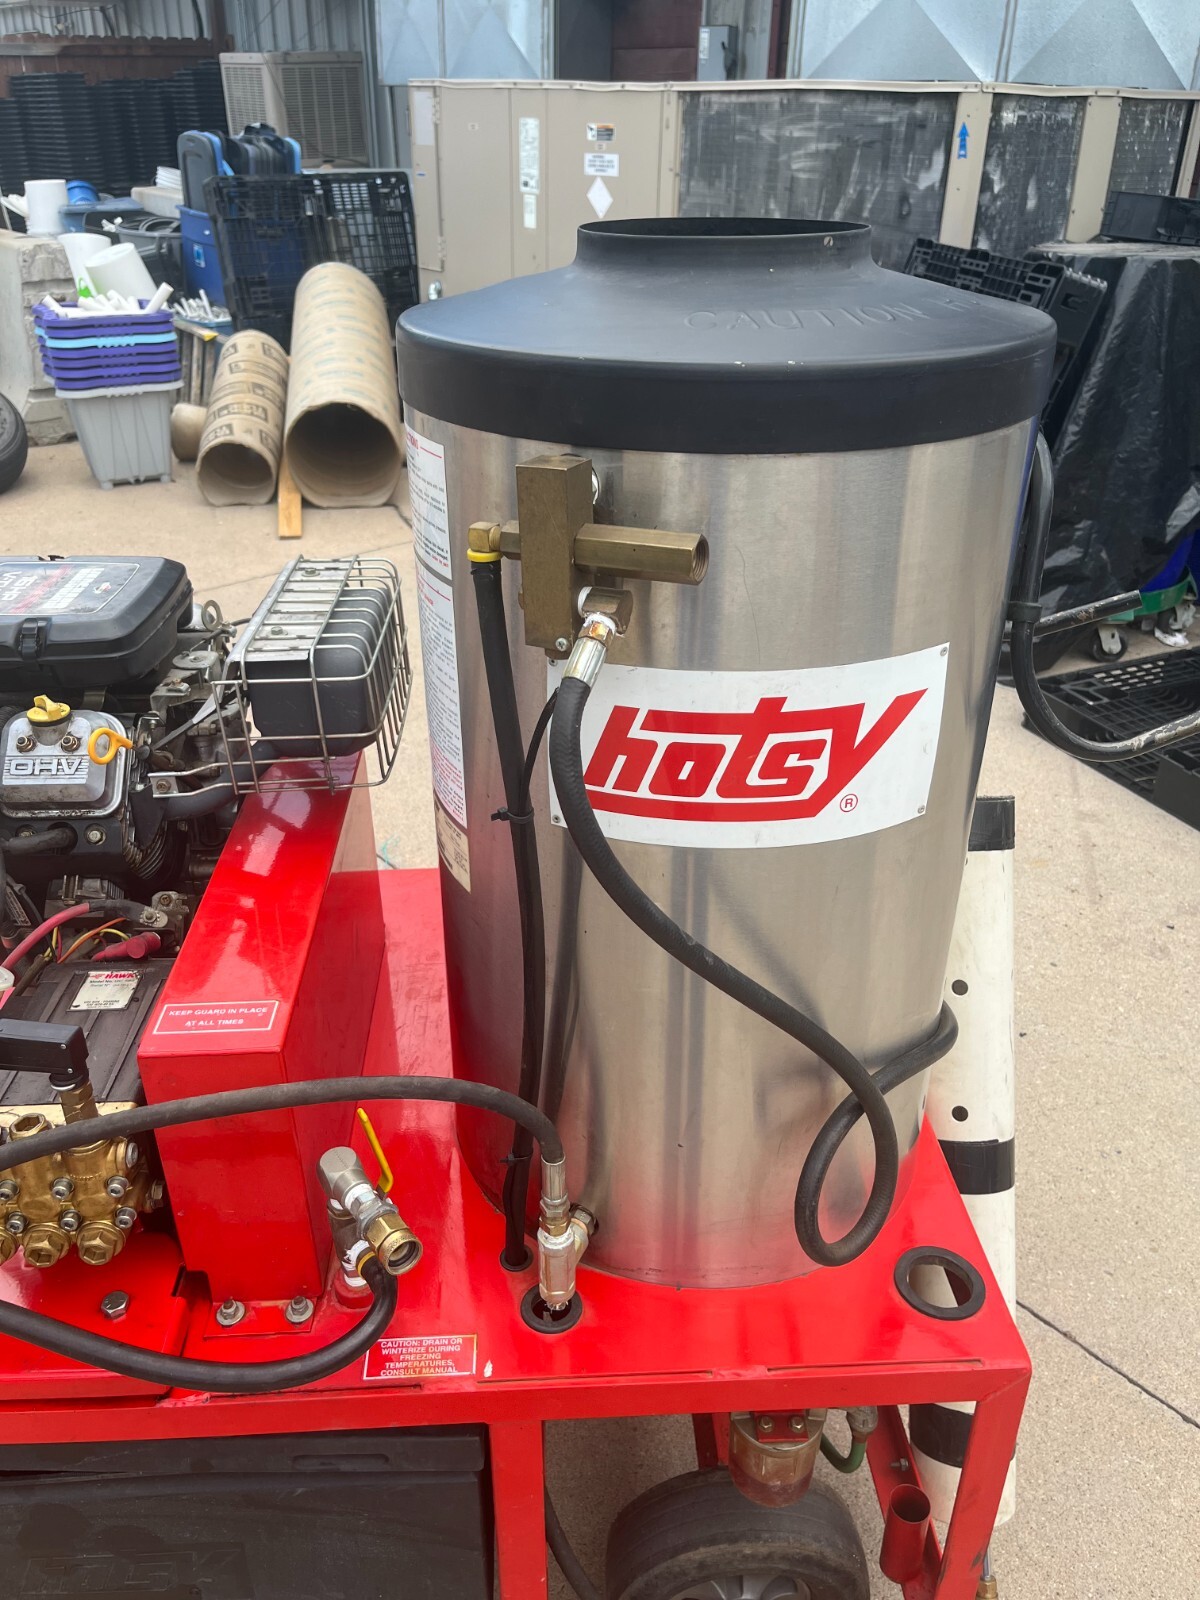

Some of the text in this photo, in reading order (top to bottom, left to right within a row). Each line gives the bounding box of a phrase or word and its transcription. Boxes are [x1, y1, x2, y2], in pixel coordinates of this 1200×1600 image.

[683, 301, 931, 330] CAUTION
[584, 688, 929, 823] hotsy
[9, 757, 83, 776] OHV
[422, 1338, 448, 1346] DRAIN
[381, 1345, 461, 1355] WINTERIZE DURING
[385, 1360, 455, 1369] TEMPERATURES,
[380, 1366, 458, 1376] CONSULT MANUAL
